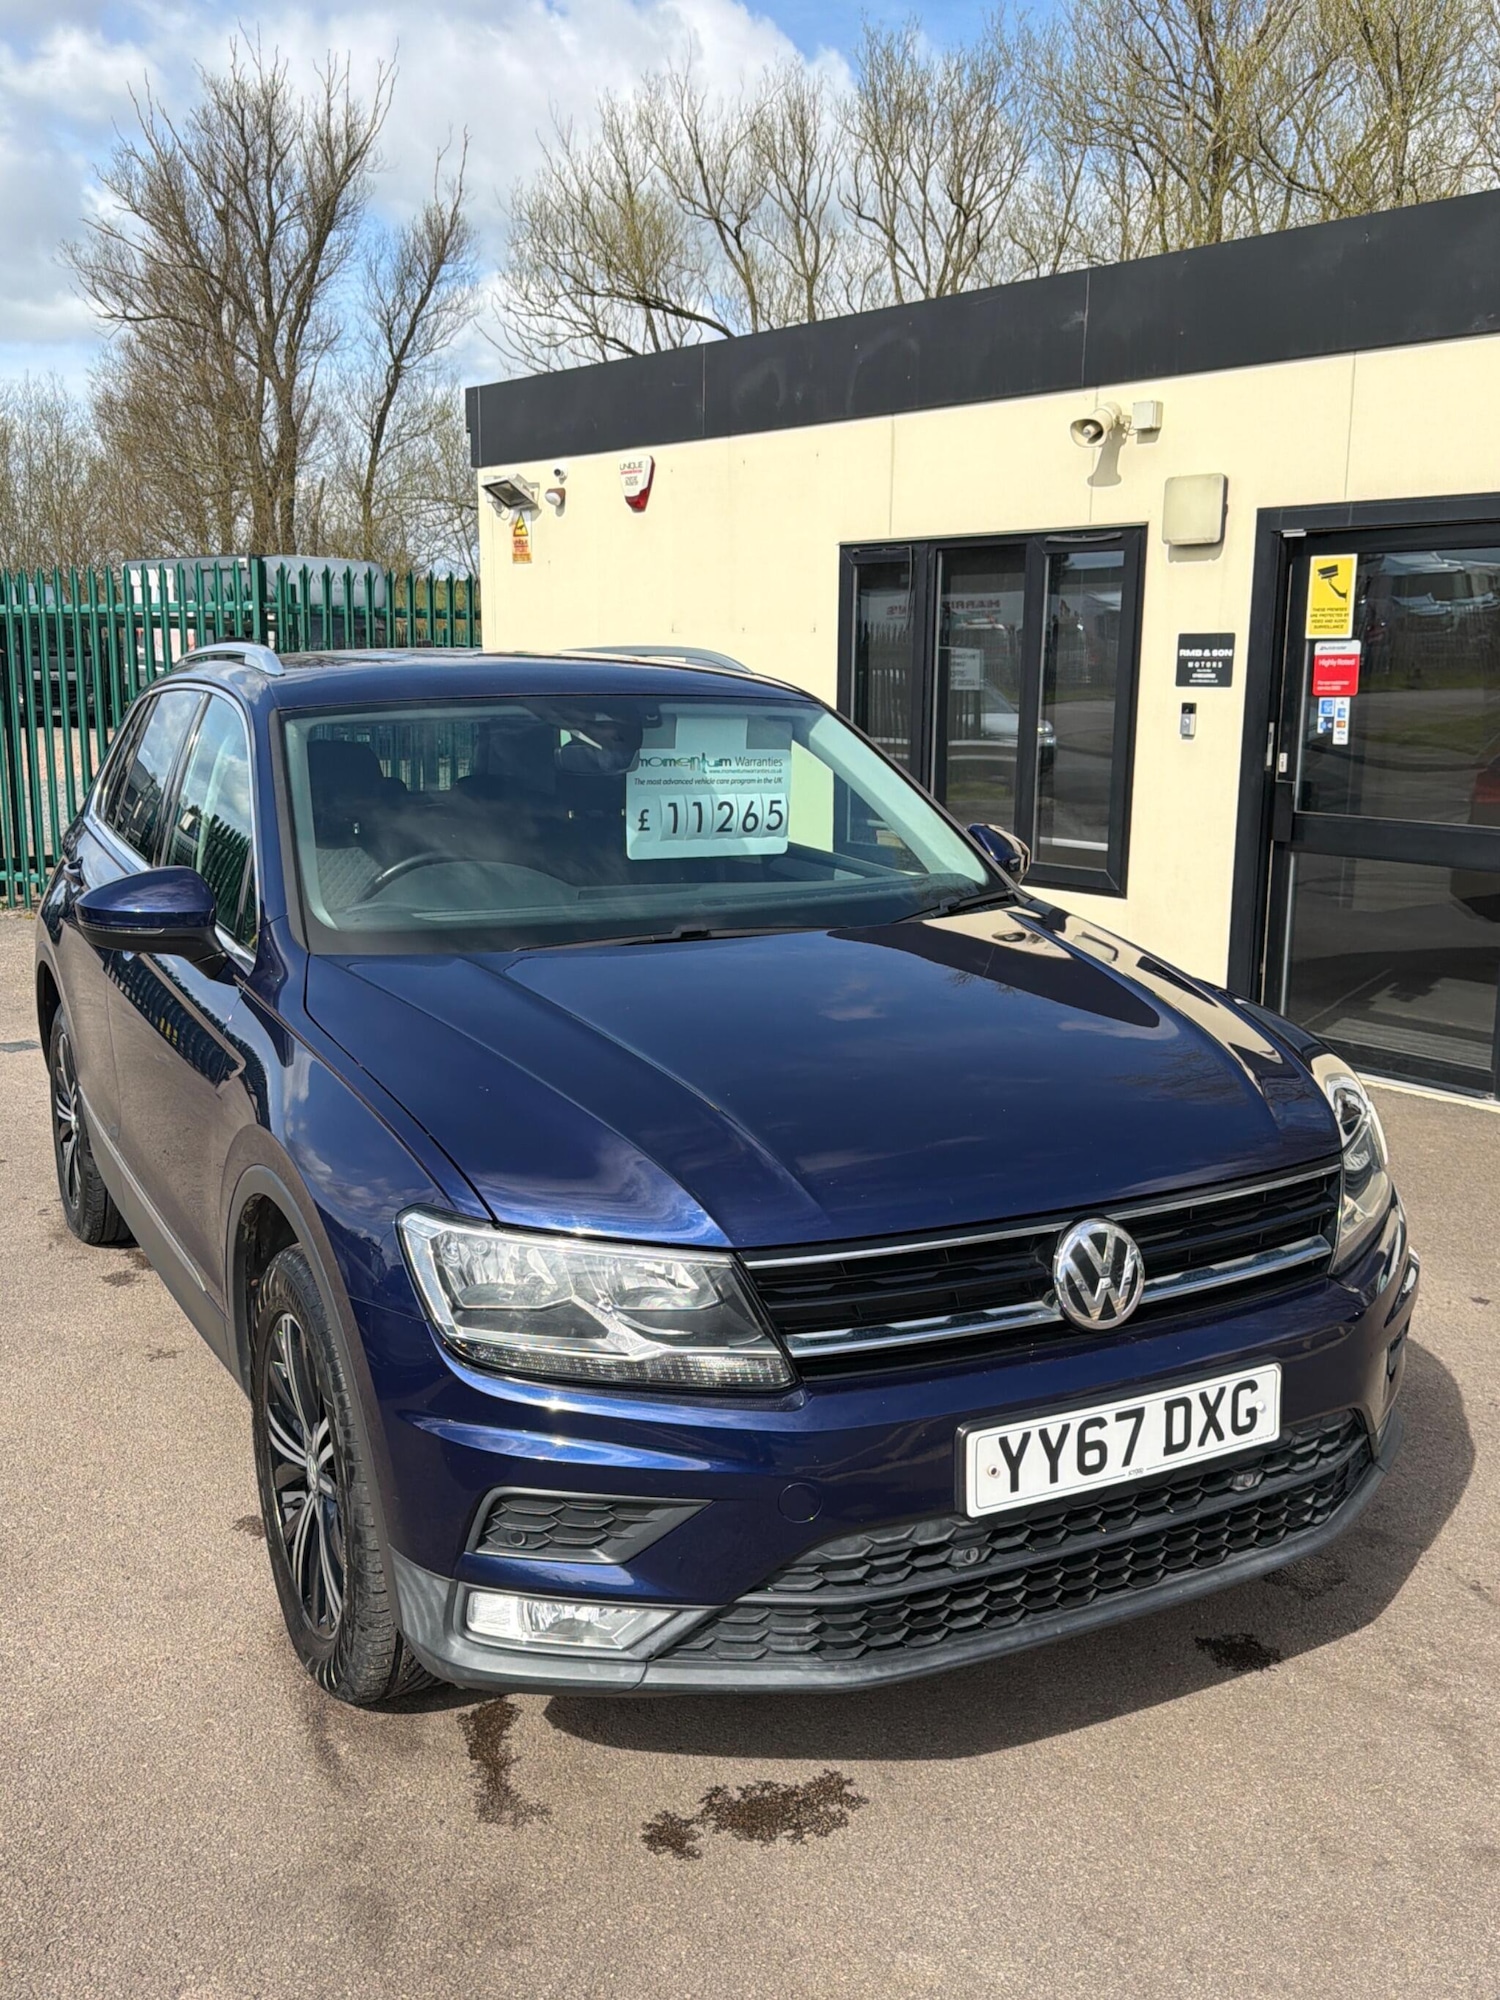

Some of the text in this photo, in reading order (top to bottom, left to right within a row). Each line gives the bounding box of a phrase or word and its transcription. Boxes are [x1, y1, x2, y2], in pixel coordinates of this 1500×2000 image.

[619, 461, 644, 471] UNIQUE
[1211, 649, 1233, 657] SON
[734, 756, 784, 767] Warranties
[634, 777, 646, 786] The
[646, 778, 662, 786] most
[662, 777, 694, 786] advanced
[694, 777, 715, 785] vehicle
[730, 778, 756, 786] program
[638, 800, 784, 834] £ 11265
[997, 1378, 1259, 1494] YY67 DXG
